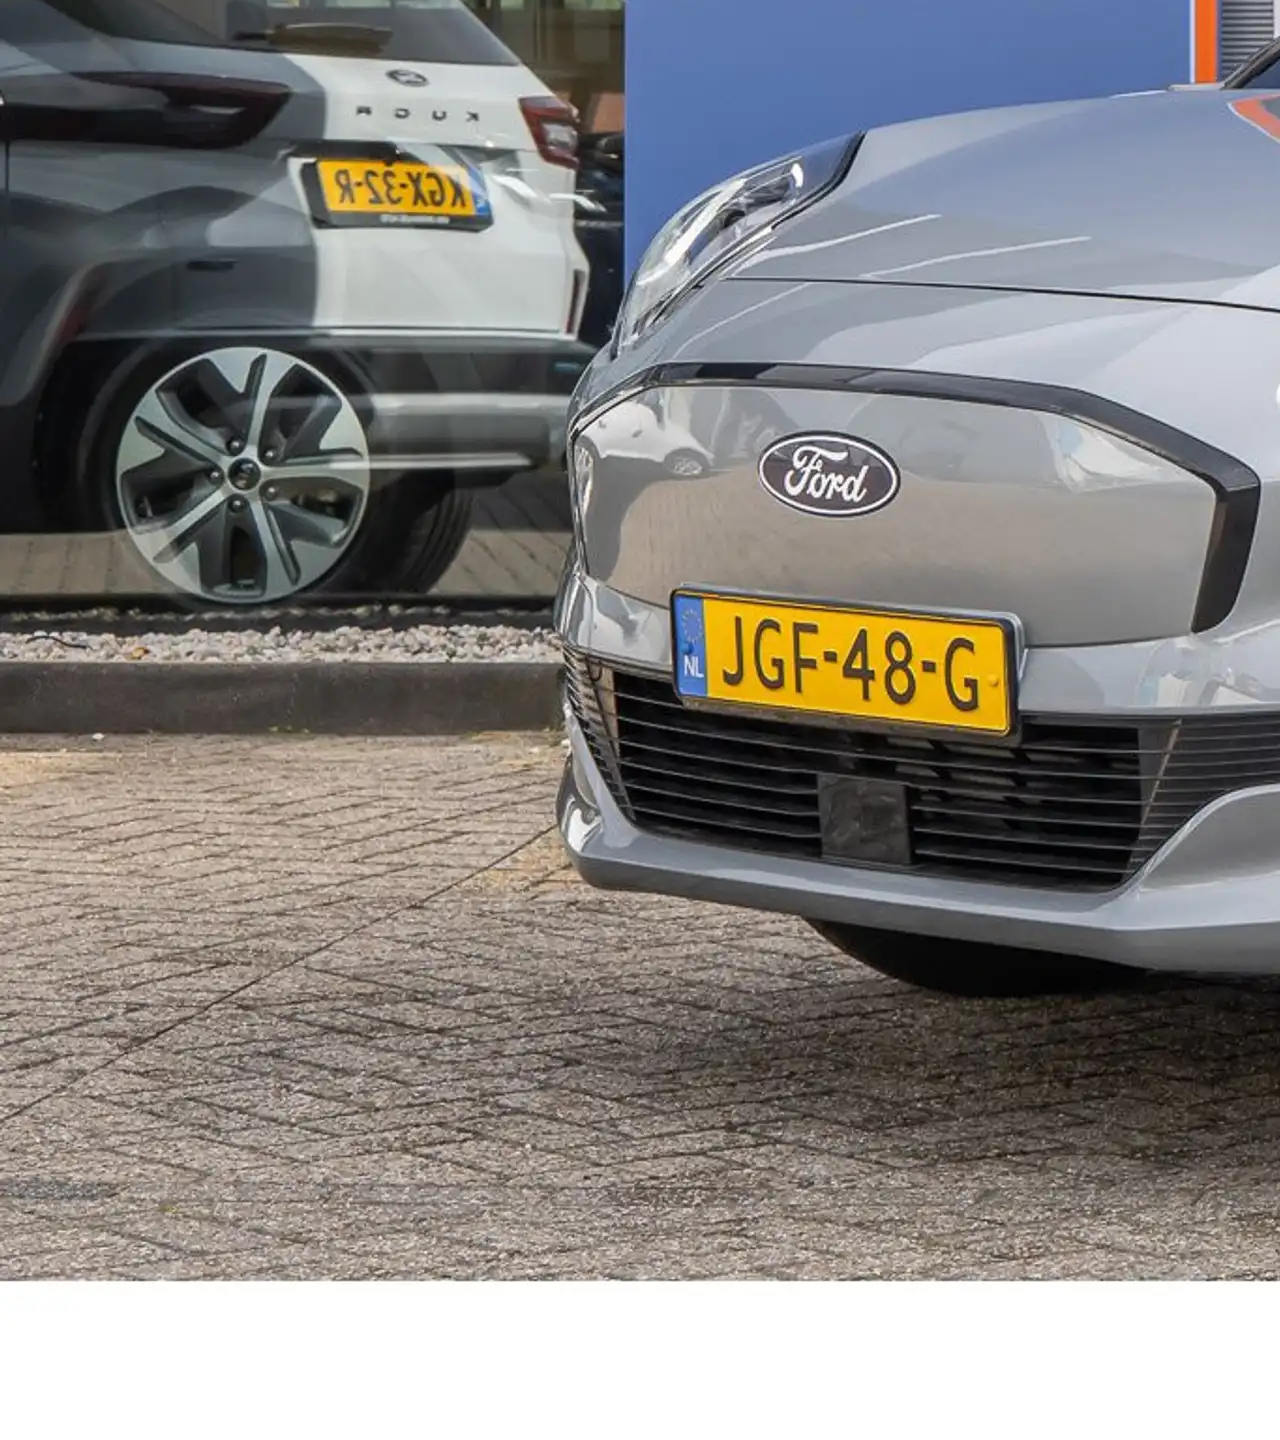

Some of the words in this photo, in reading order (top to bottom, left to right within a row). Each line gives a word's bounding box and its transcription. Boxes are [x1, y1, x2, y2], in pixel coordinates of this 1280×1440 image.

[784, 445, 869, 503] Ford
[683, 654, 704, 678] NL
[722, 615, 980, 712] JGF-48-G
